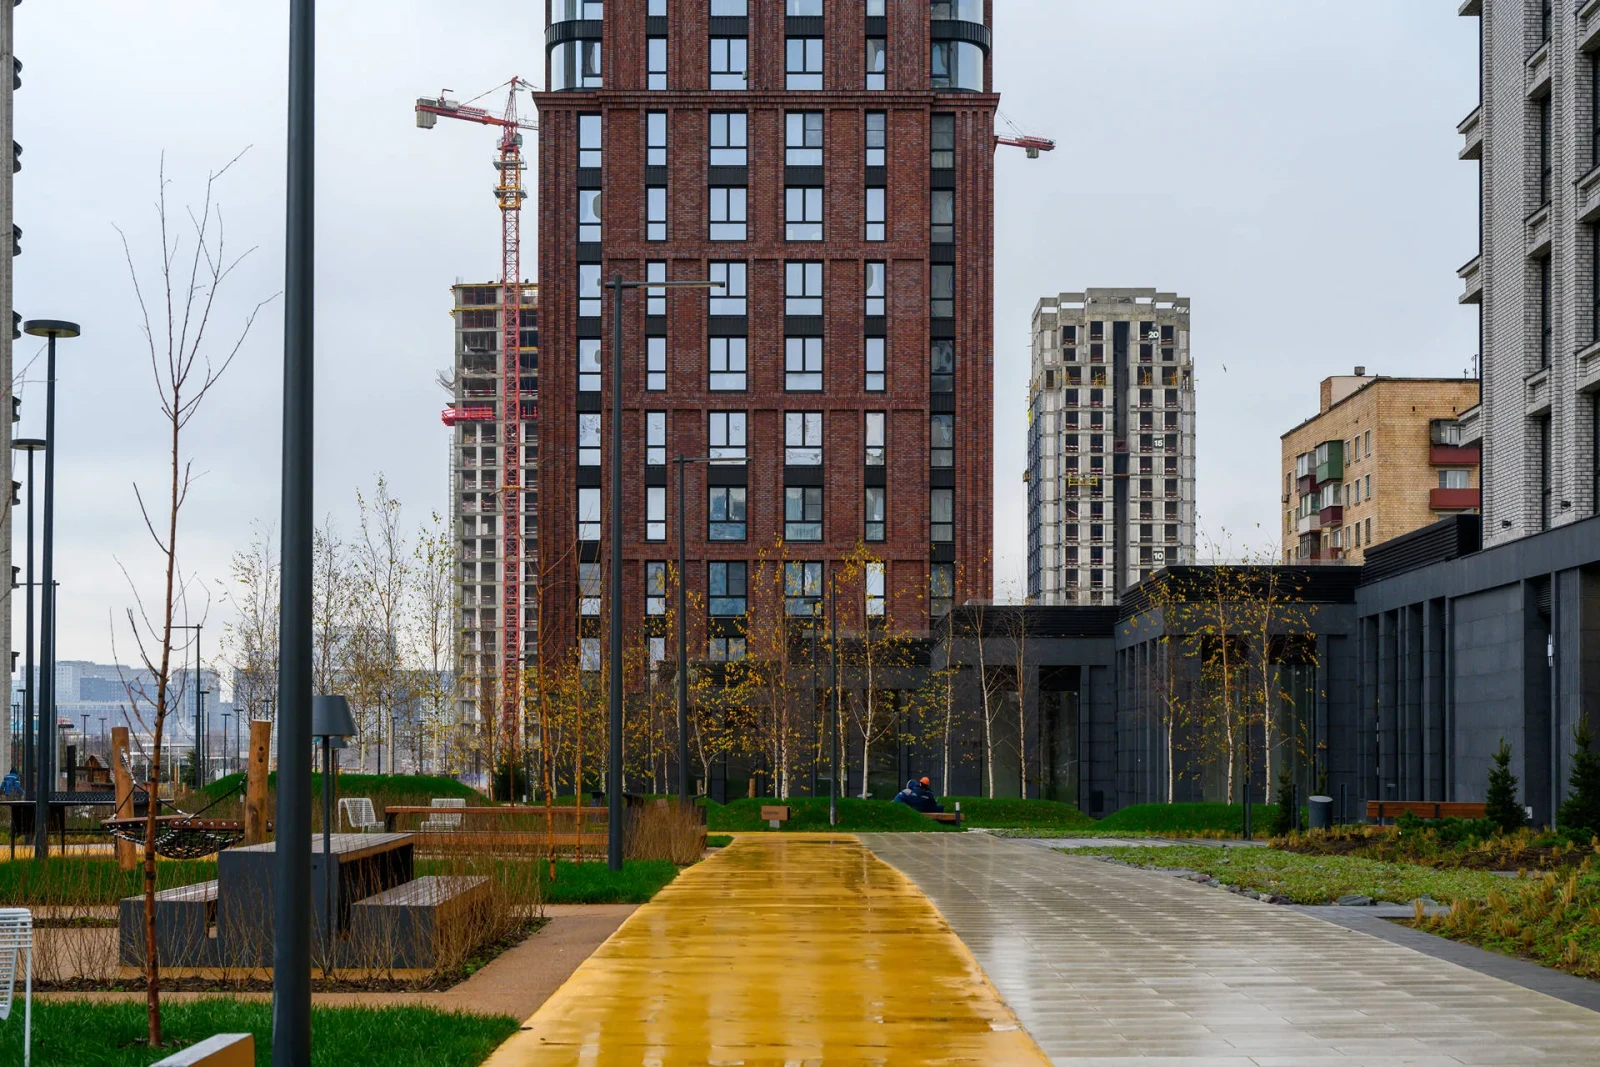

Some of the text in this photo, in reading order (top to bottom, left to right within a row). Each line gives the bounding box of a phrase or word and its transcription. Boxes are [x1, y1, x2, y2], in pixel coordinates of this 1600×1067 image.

[1148, 331, 1159, 339] 20
[1154, 439, 1163, 447] 15
[1153, 552, 1163, 560] 10
